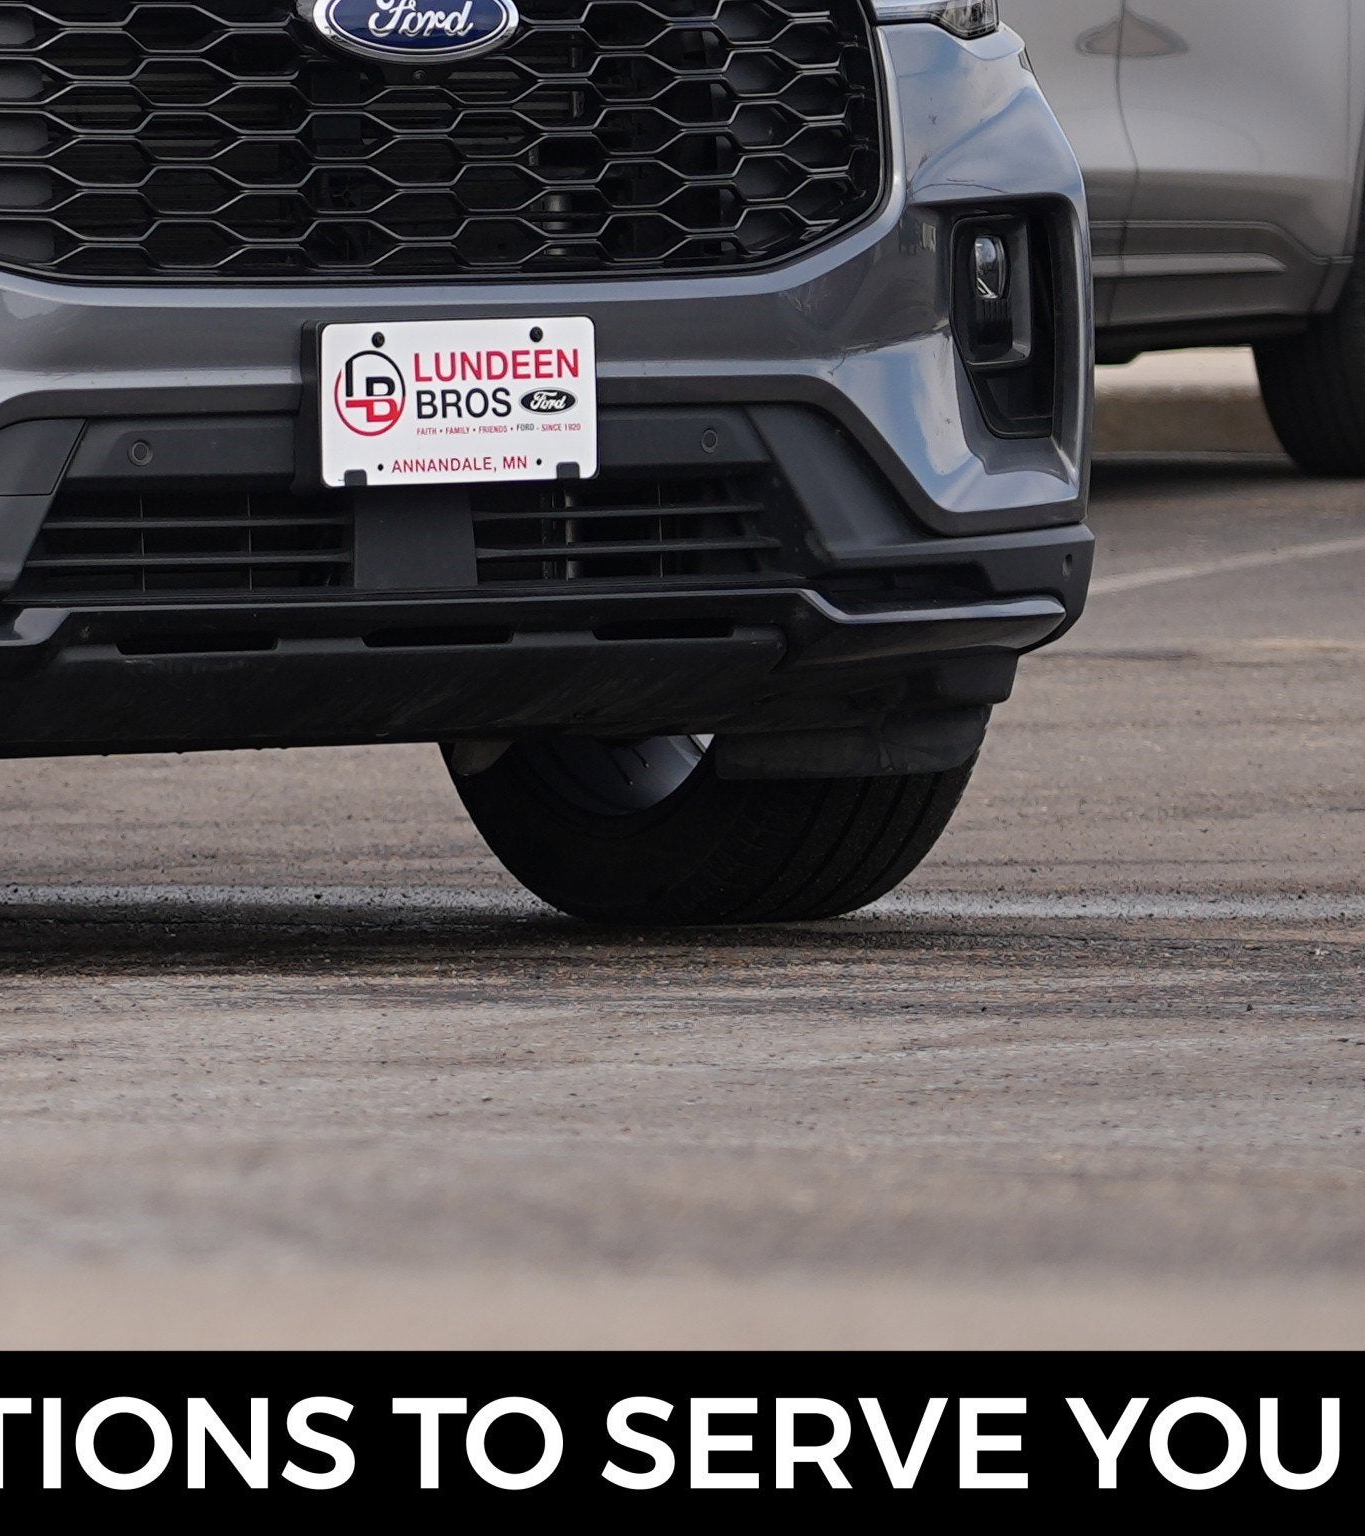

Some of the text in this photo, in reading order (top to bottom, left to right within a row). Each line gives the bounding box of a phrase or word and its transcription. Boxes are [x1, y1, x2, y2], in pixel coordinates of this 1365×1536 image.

[413, 348, 580, 383] LUNDEEN
[416, 388, 513, 420] BROS
[391, 456, 528, 474] ANNANDALE, MN
